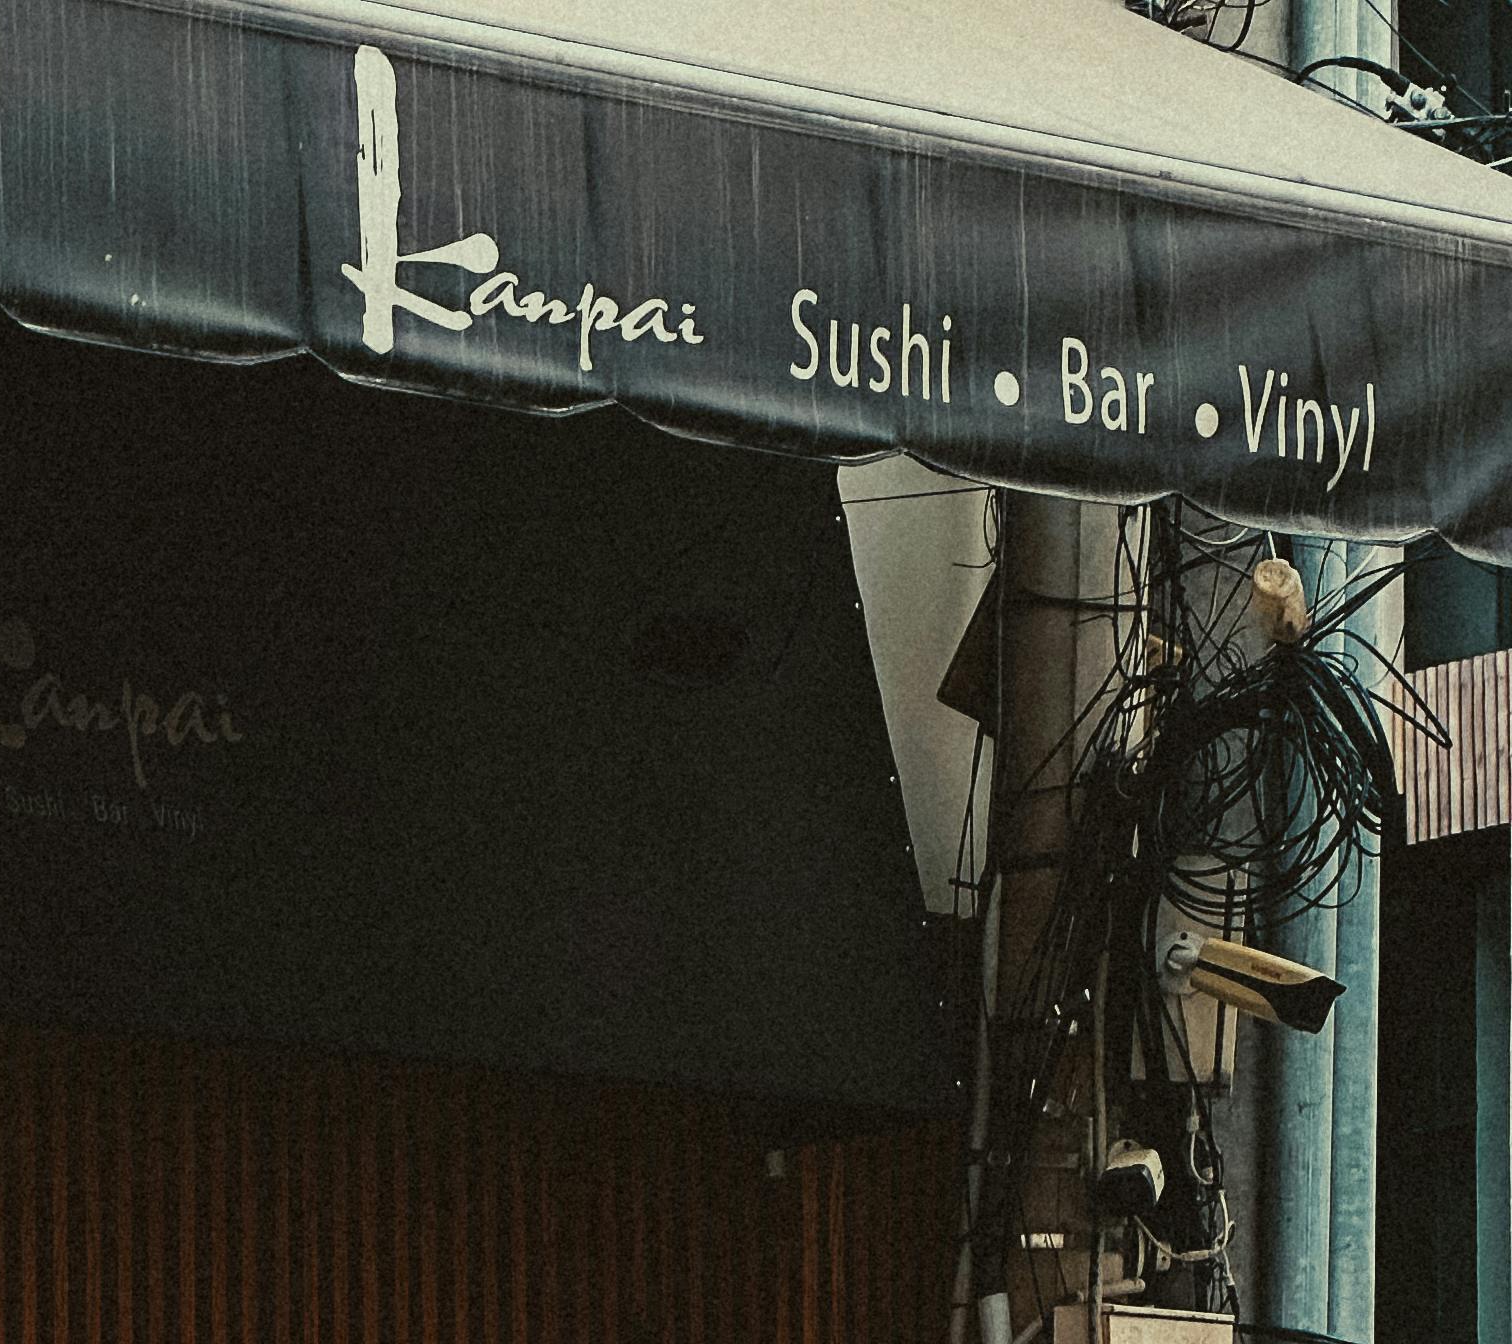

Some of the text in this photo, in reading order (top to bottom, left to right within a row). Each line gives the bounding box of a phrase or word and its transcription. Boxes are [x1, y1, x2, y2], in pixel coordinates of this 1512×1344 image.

[341, 44, 705, 372] Kanpai
[788, 288, 1376, 493] Sushi Bar Vinyl
